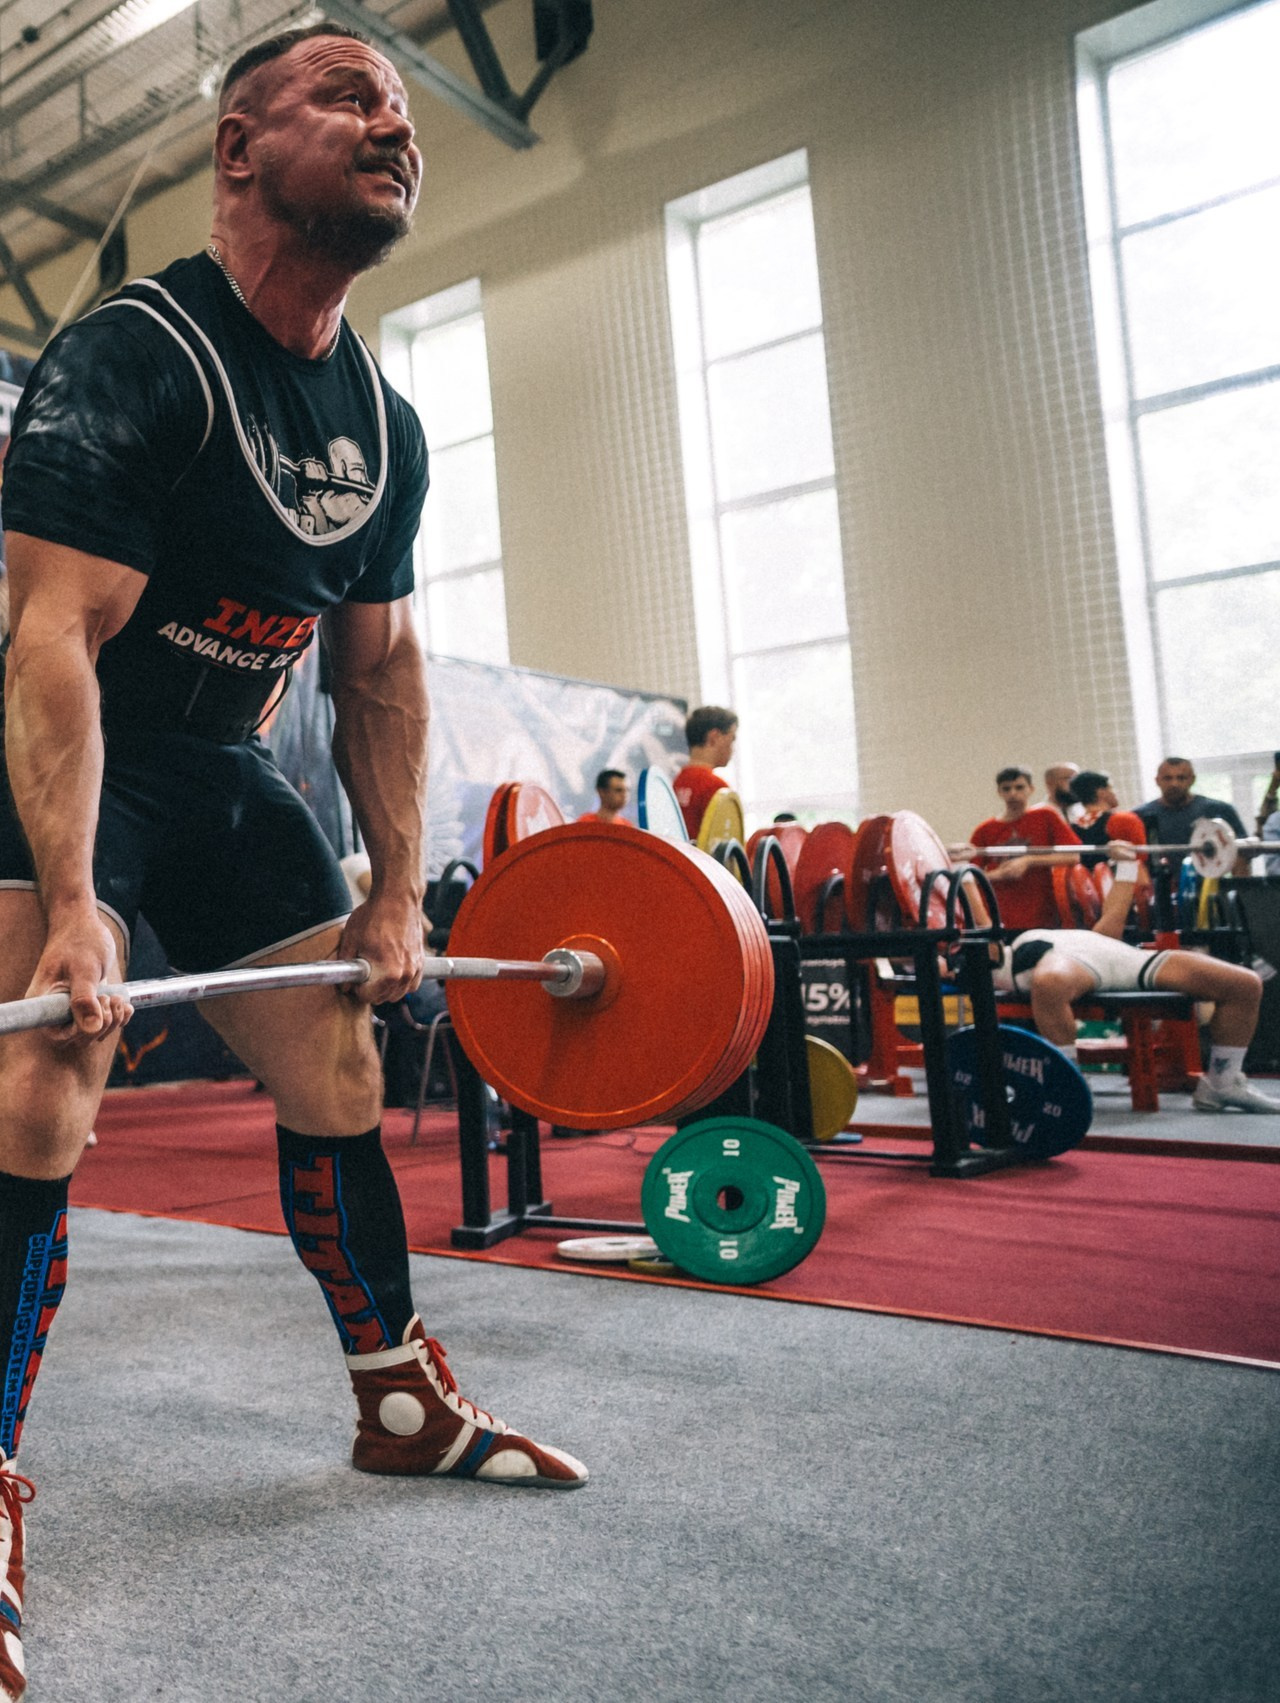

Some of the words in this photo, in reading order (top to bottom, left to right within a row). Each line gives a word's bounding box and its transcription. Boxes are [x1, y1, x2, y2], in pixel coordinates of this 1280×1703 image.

[157, 621, 269, 670] ADVANCE
[722, 1138, 741, 1157] 10
[664, 1169, 695, 1224] POWER
[770, 1175, 801, 1230] POWER
[19, 1235, 47, 1316] SUPPORT
[719, 1239, 739, 1261] 10
